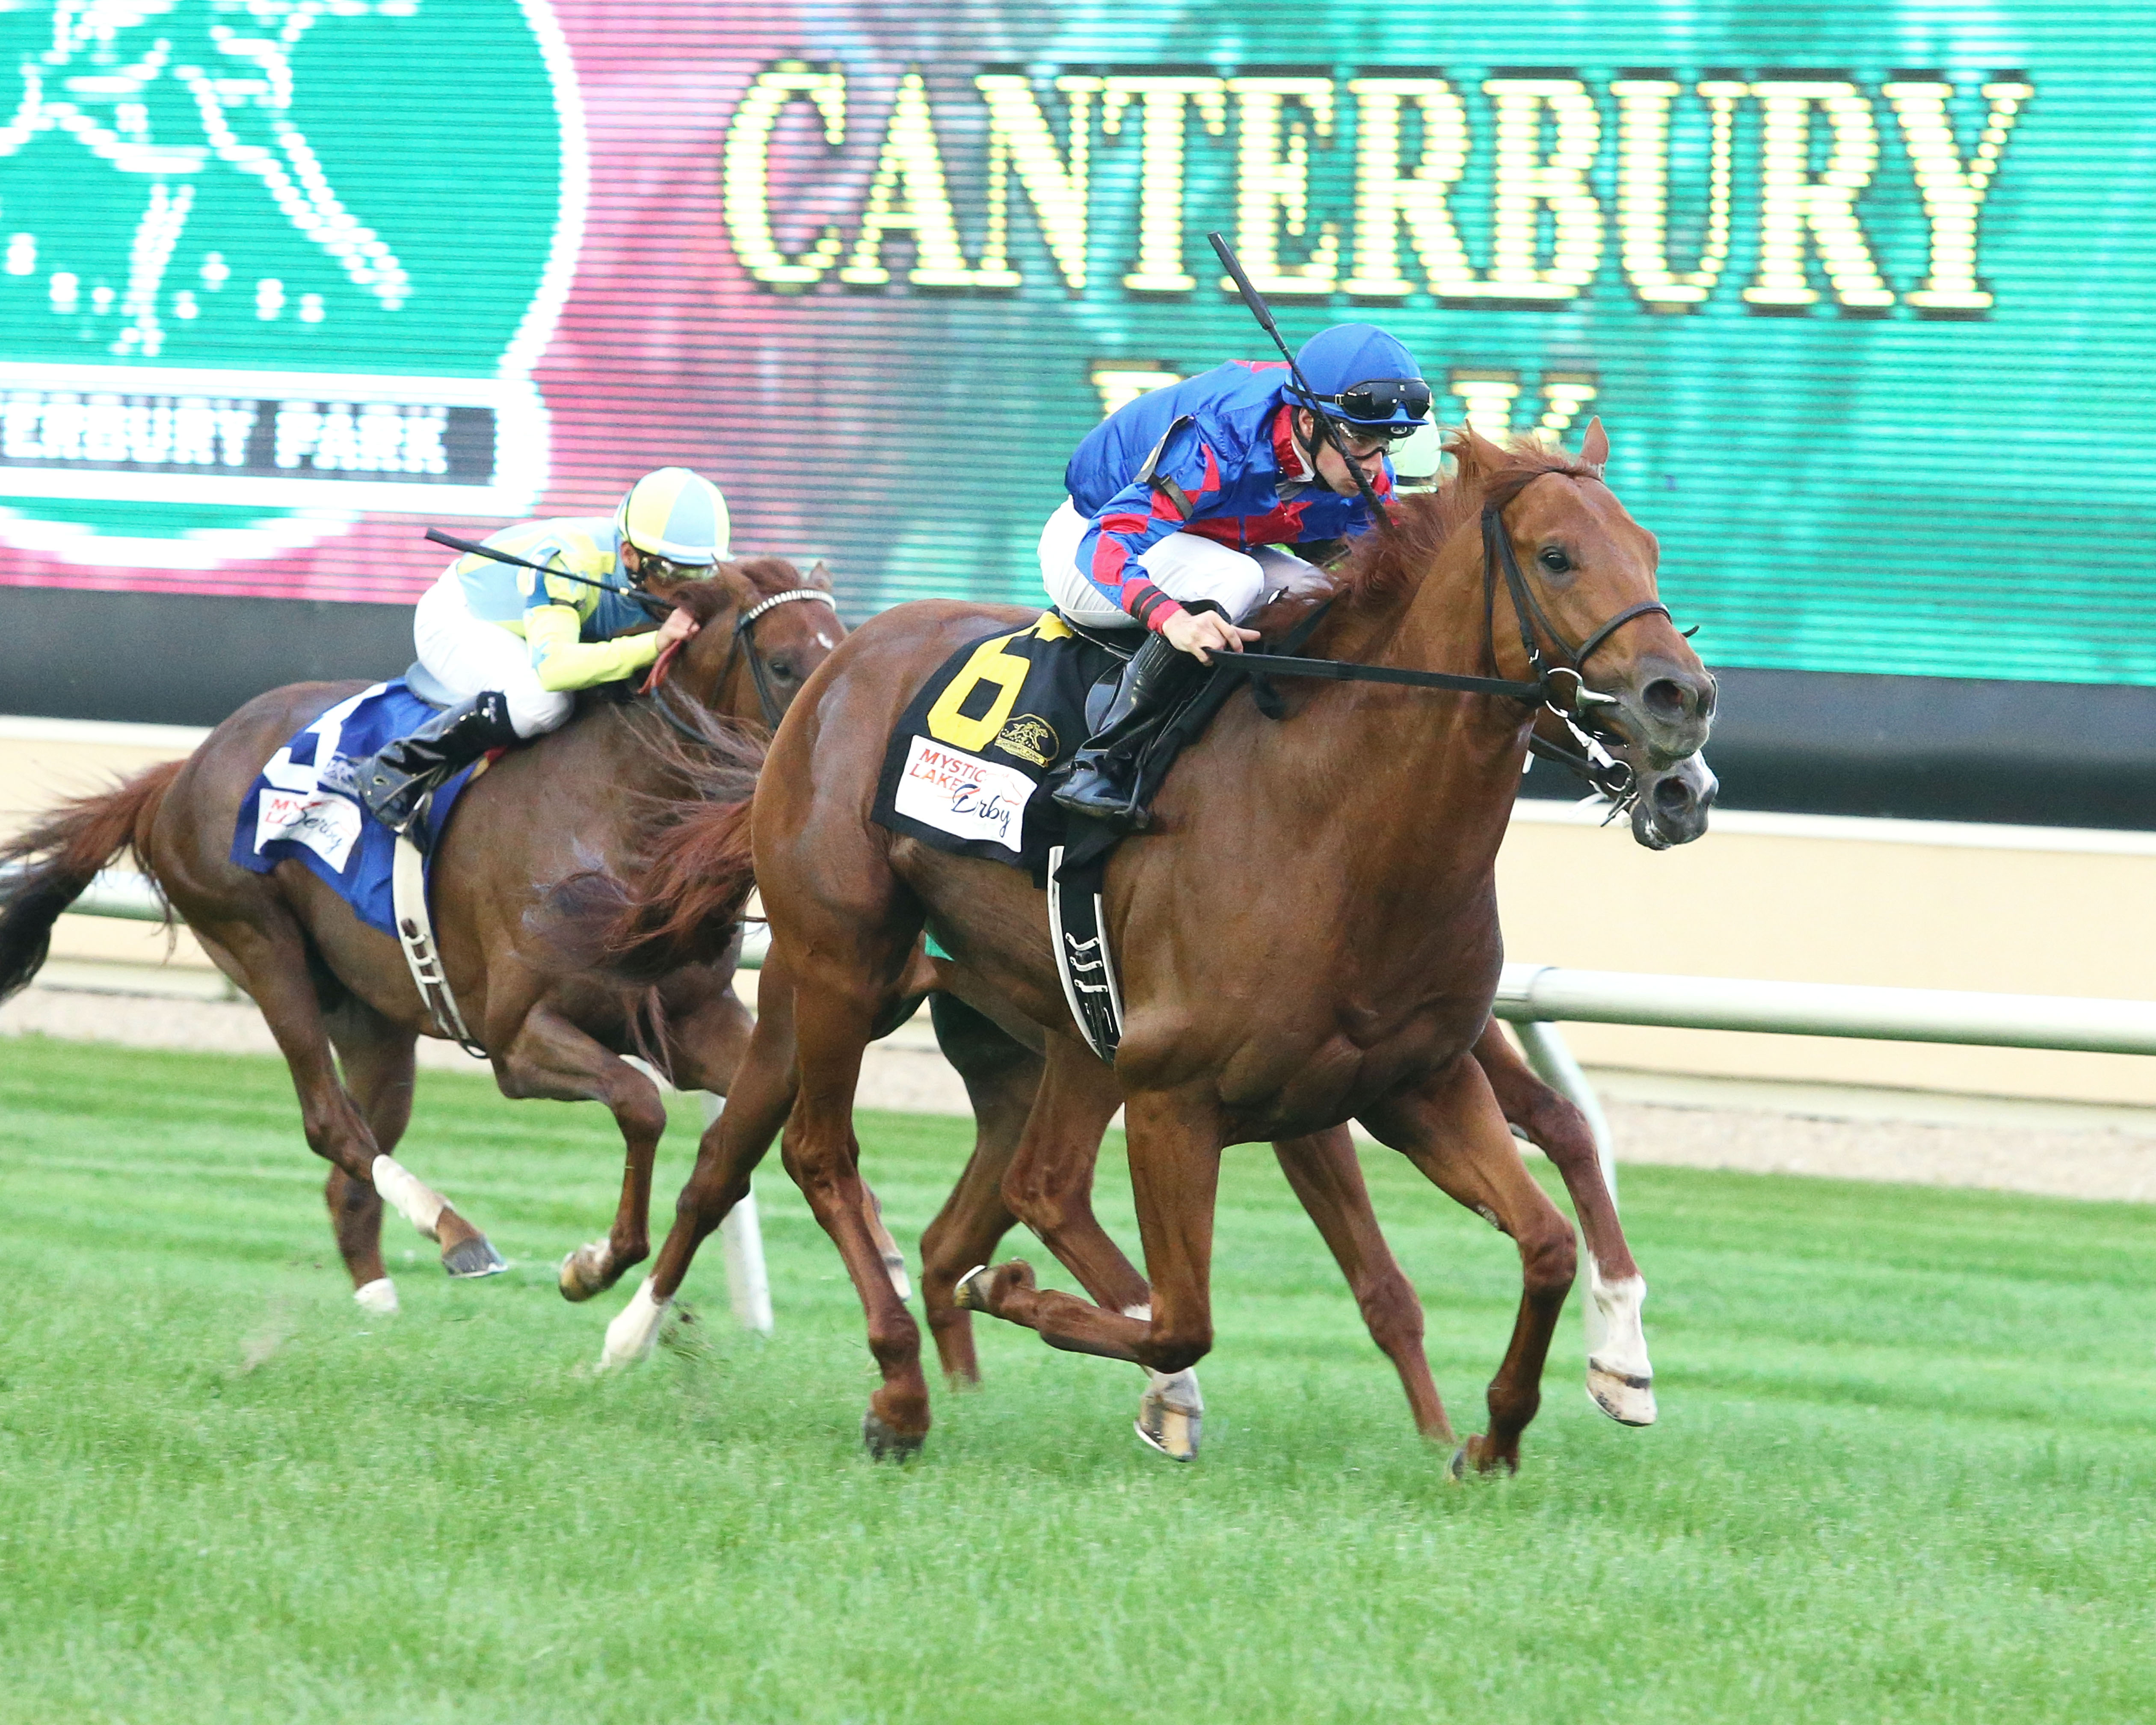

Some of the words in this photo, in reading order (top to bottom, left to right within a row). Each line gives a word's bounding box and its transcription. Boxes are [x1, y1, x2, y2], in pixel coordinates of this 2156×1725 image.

[723, 61, 2033, 306] CANTERBURY
[275, 401, 449, 474] PARK
[927, 612, 1072, 752] 6
[909, 764, 965, 792] LAKE
[919, 749, 986, 782] MYSTIC
[951, 784, 1011, 837] Drby
